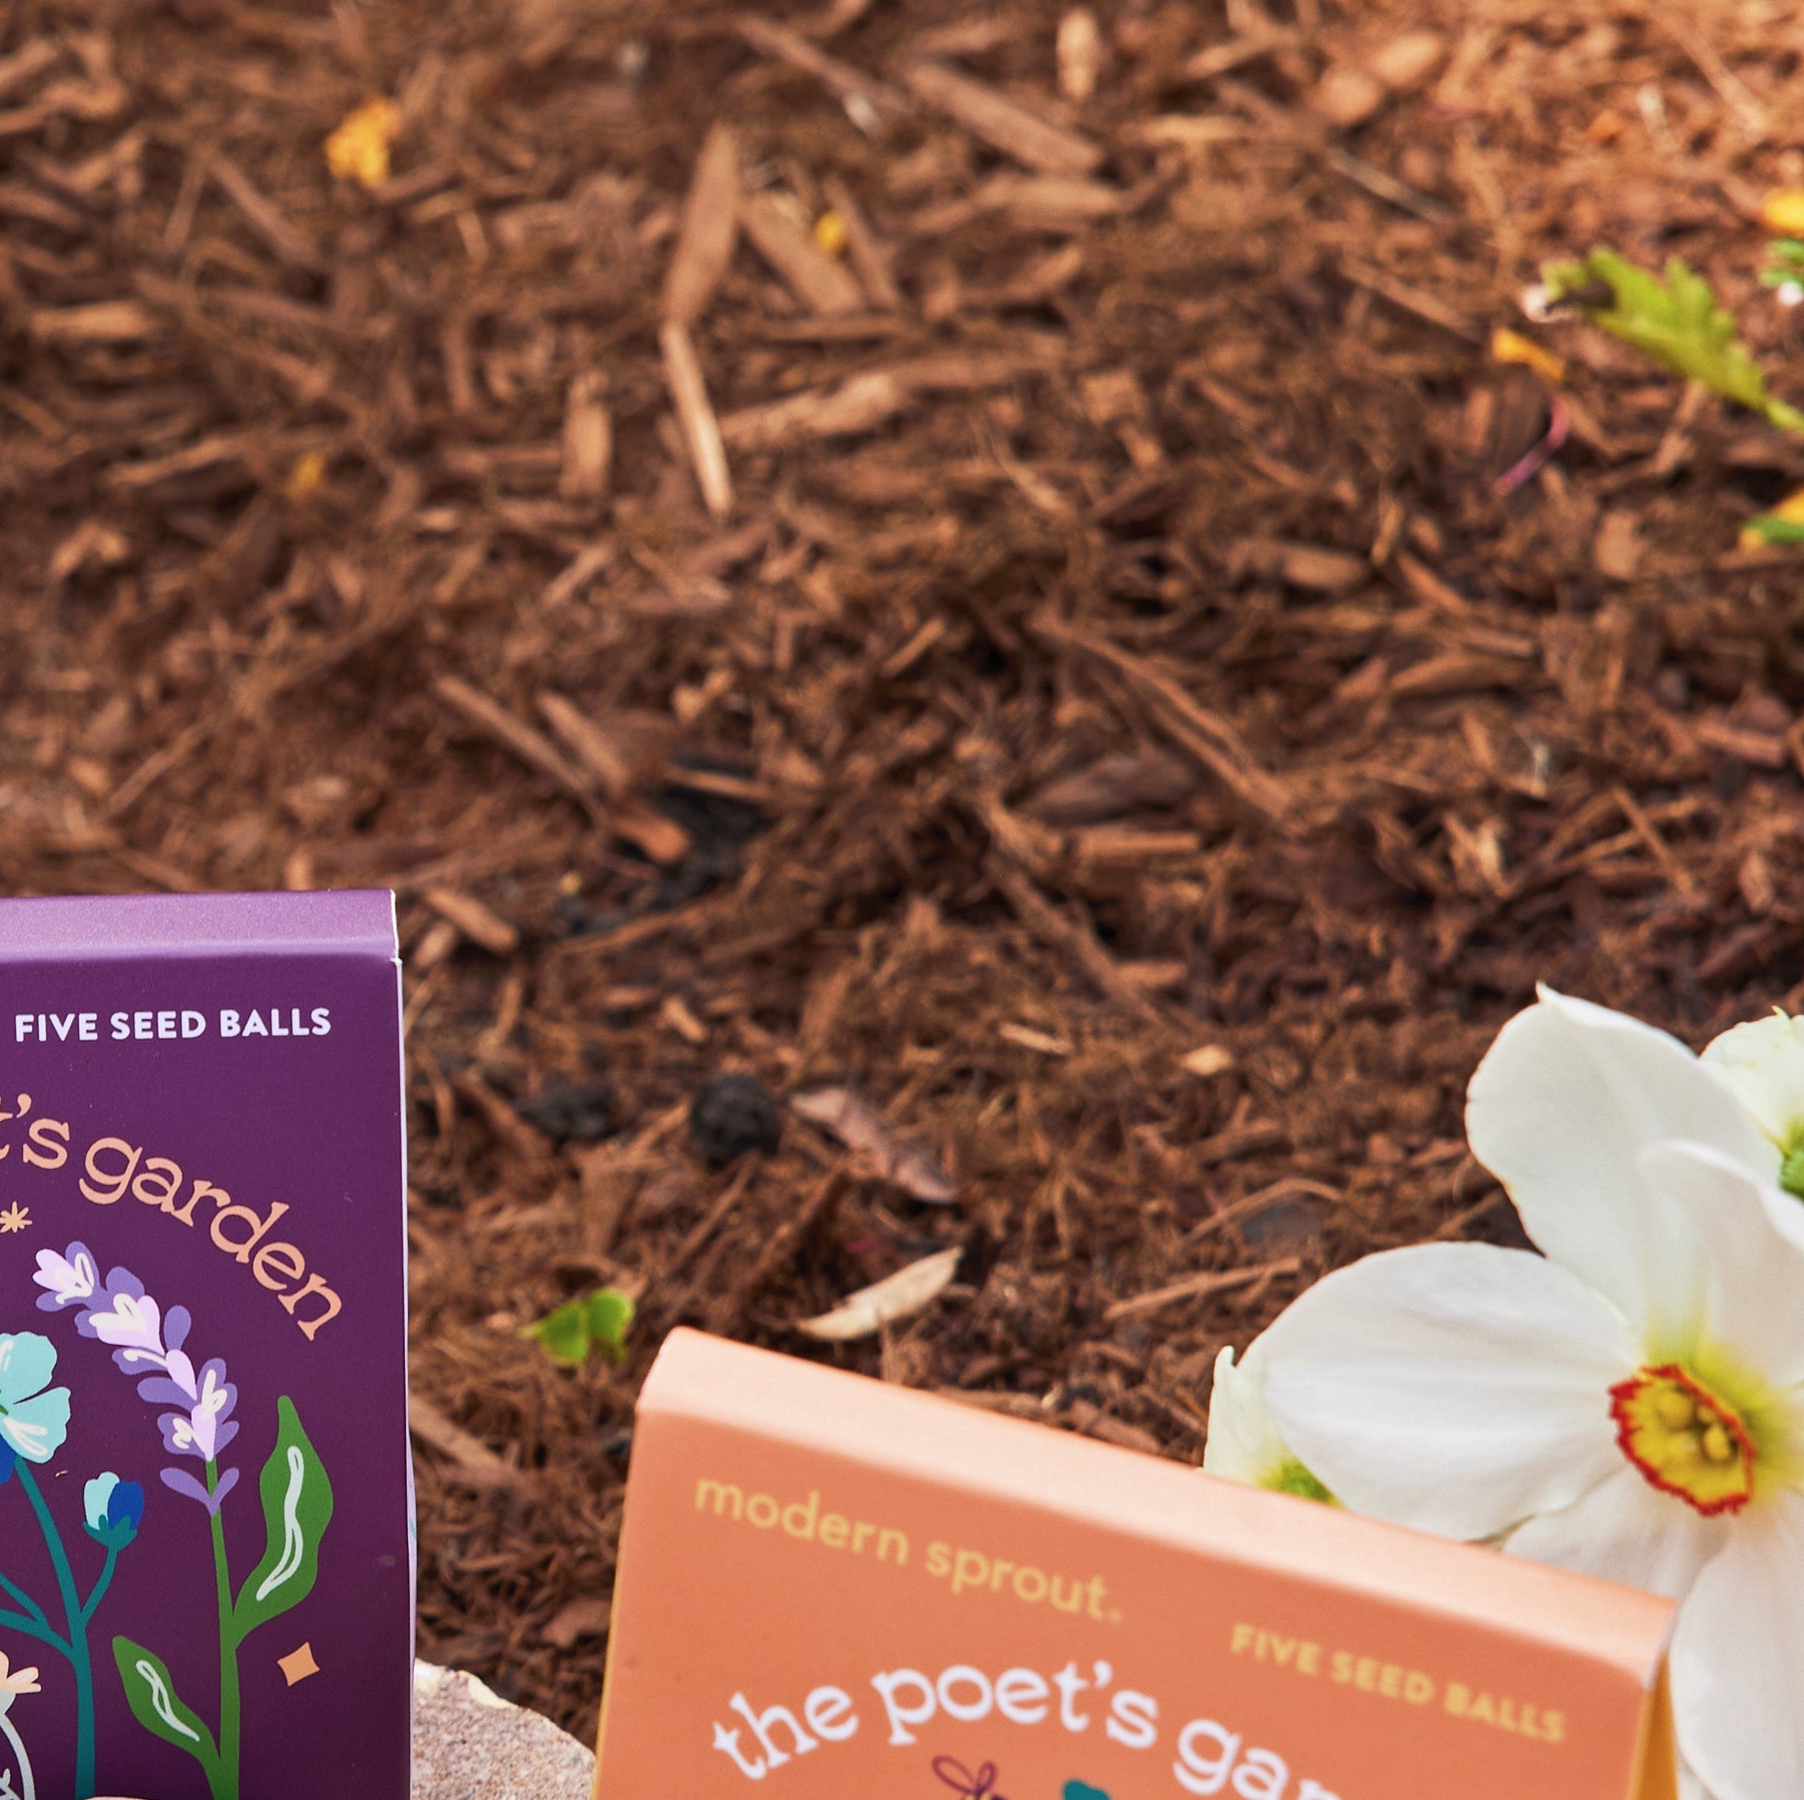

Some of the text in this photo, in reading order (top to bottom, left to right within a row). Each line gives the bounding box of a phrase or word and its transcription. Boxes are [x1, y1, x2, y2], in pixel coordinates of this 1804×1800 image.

[15, 1007, 332, 1042] FIVE SEED BALLS
[79, 1136, 343, 1342] garden
[695, 1477, 910, 1566] modern
[712, 1684, 859, 1780] the
[871, 1660, 1159, 1750] poet’s
[1230, 1622, 1566, 1744] FIVE SEED BALLS
